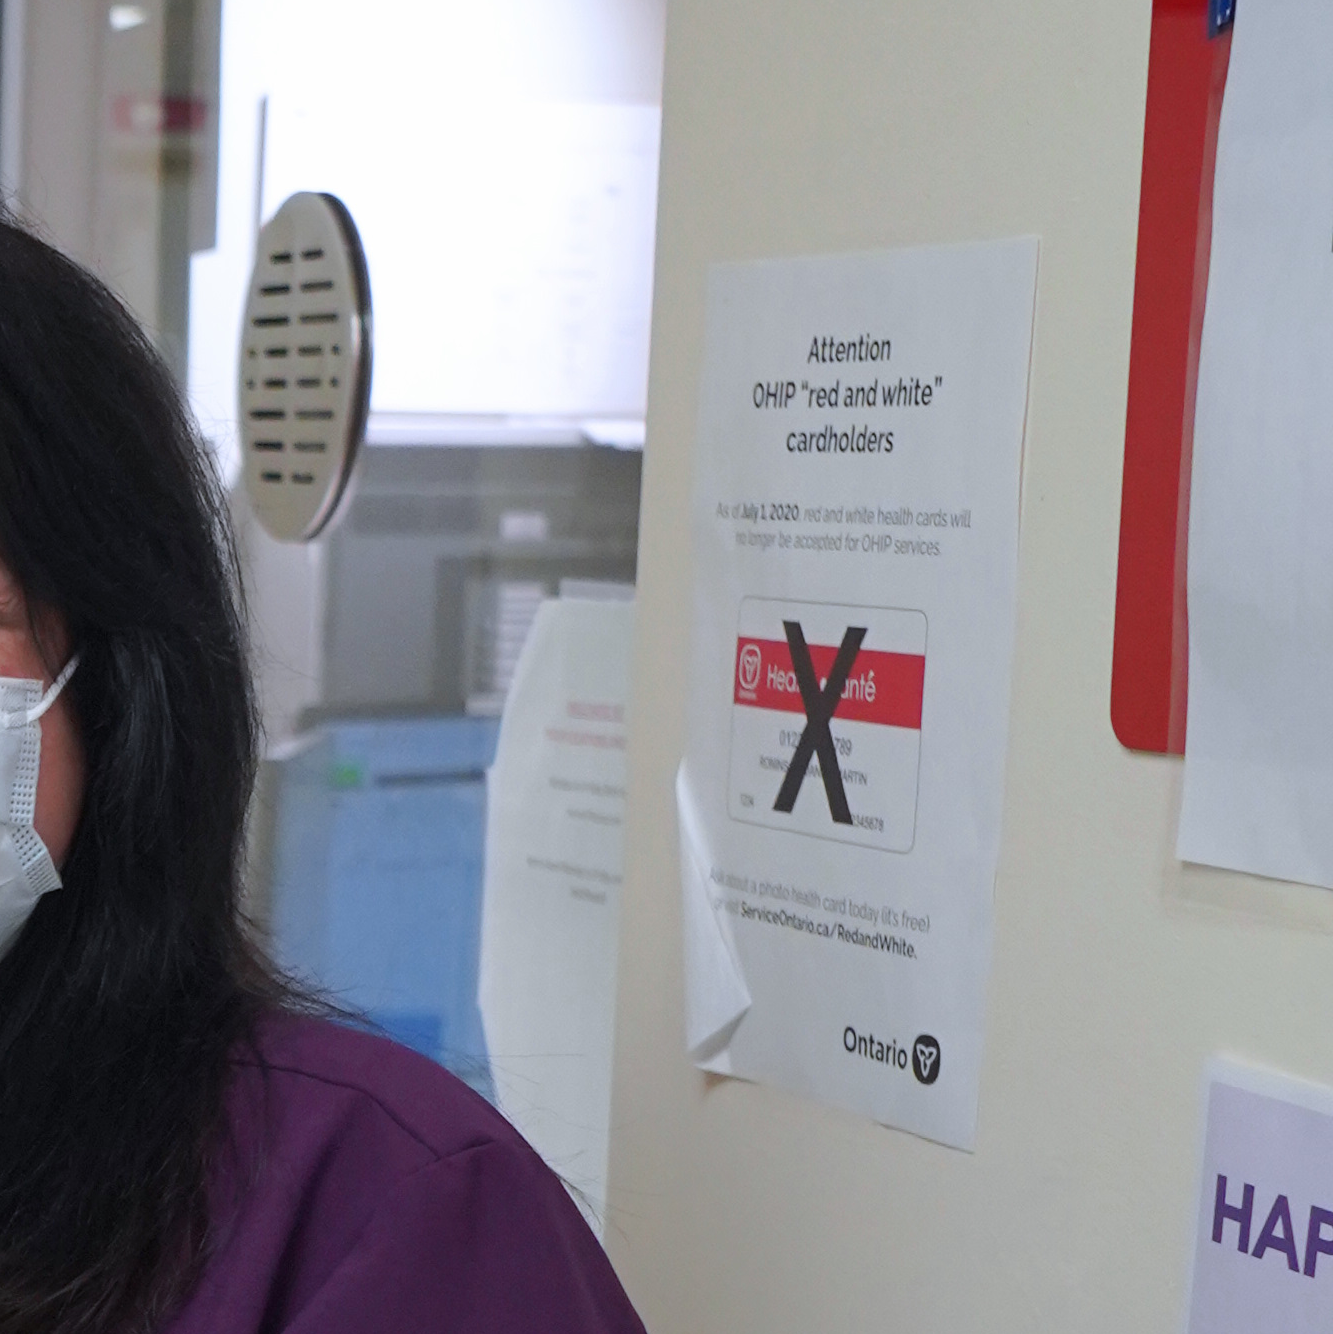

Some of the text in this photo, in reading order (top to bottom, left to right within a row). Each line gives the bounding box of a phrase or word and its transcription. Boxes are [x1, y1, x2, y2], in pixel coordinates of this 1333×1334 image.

[807, 333, 891, 364] Attention
[752, 381, 796, 409] OHIP
[844, 378, 878, 408] and
[882, 375, 943, 408] white"
[786, 424, 894, 453] cardholders
[877, 507, 914, 526] health
[915, 509, 948, 528] cards
[950, 509, 971, 529] will
[861, 534, 892, 554] OHIP
[822, 897, 846, 916] card
[849, 899, 879, 927] today
[843, 1026, 908, 1070] Ontario
